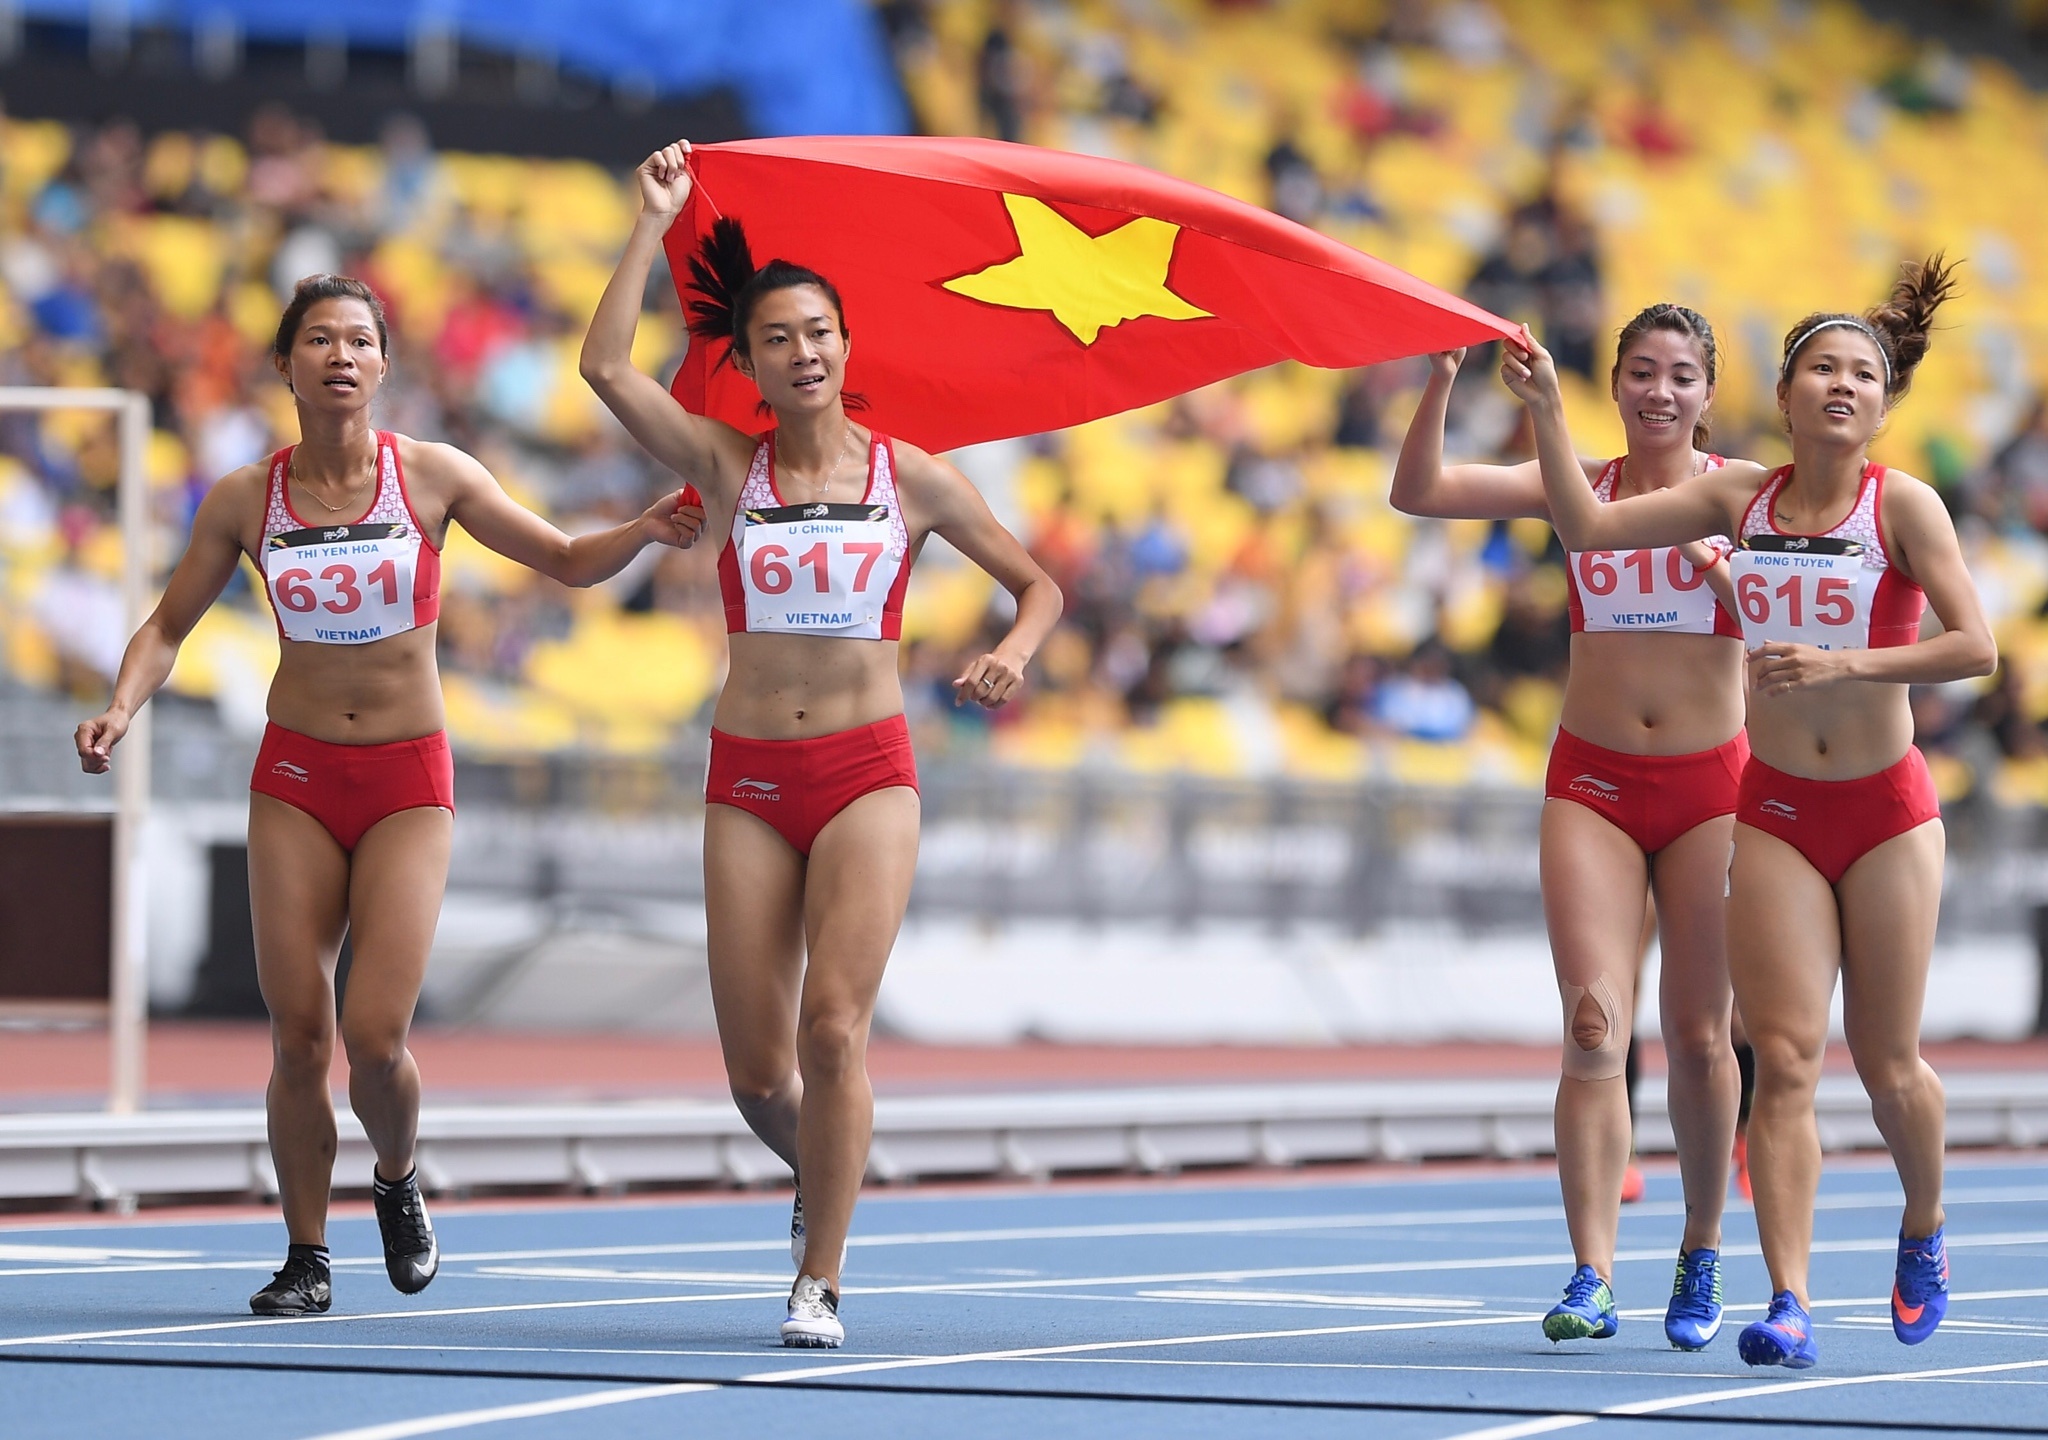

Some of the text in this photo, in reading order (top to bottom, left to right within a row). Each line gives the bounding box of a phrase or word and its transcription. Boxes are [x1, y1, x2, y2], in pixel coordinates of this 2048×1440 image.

[788, 525, 844, 535] U CHINH
[296, 544, 379, 560] THI YEN HOA
[750, 541, 884, 595] 617
[1754, 556, 1834, 568] MONG TUYEN
[1579, 546, 1706, 596] 610
[275, 559, 399, 615] 631
[1737, 573, 1855, 627] 615
[785, 612, 853, 625] VIETNAM
[1612, 611, 1678, 625] VIETNAM
[315, 625, 382, 641] VIETNAM
[732, 790, 780, 802] LI-NING
[1568, 783, 1620, 802] LI-NING
